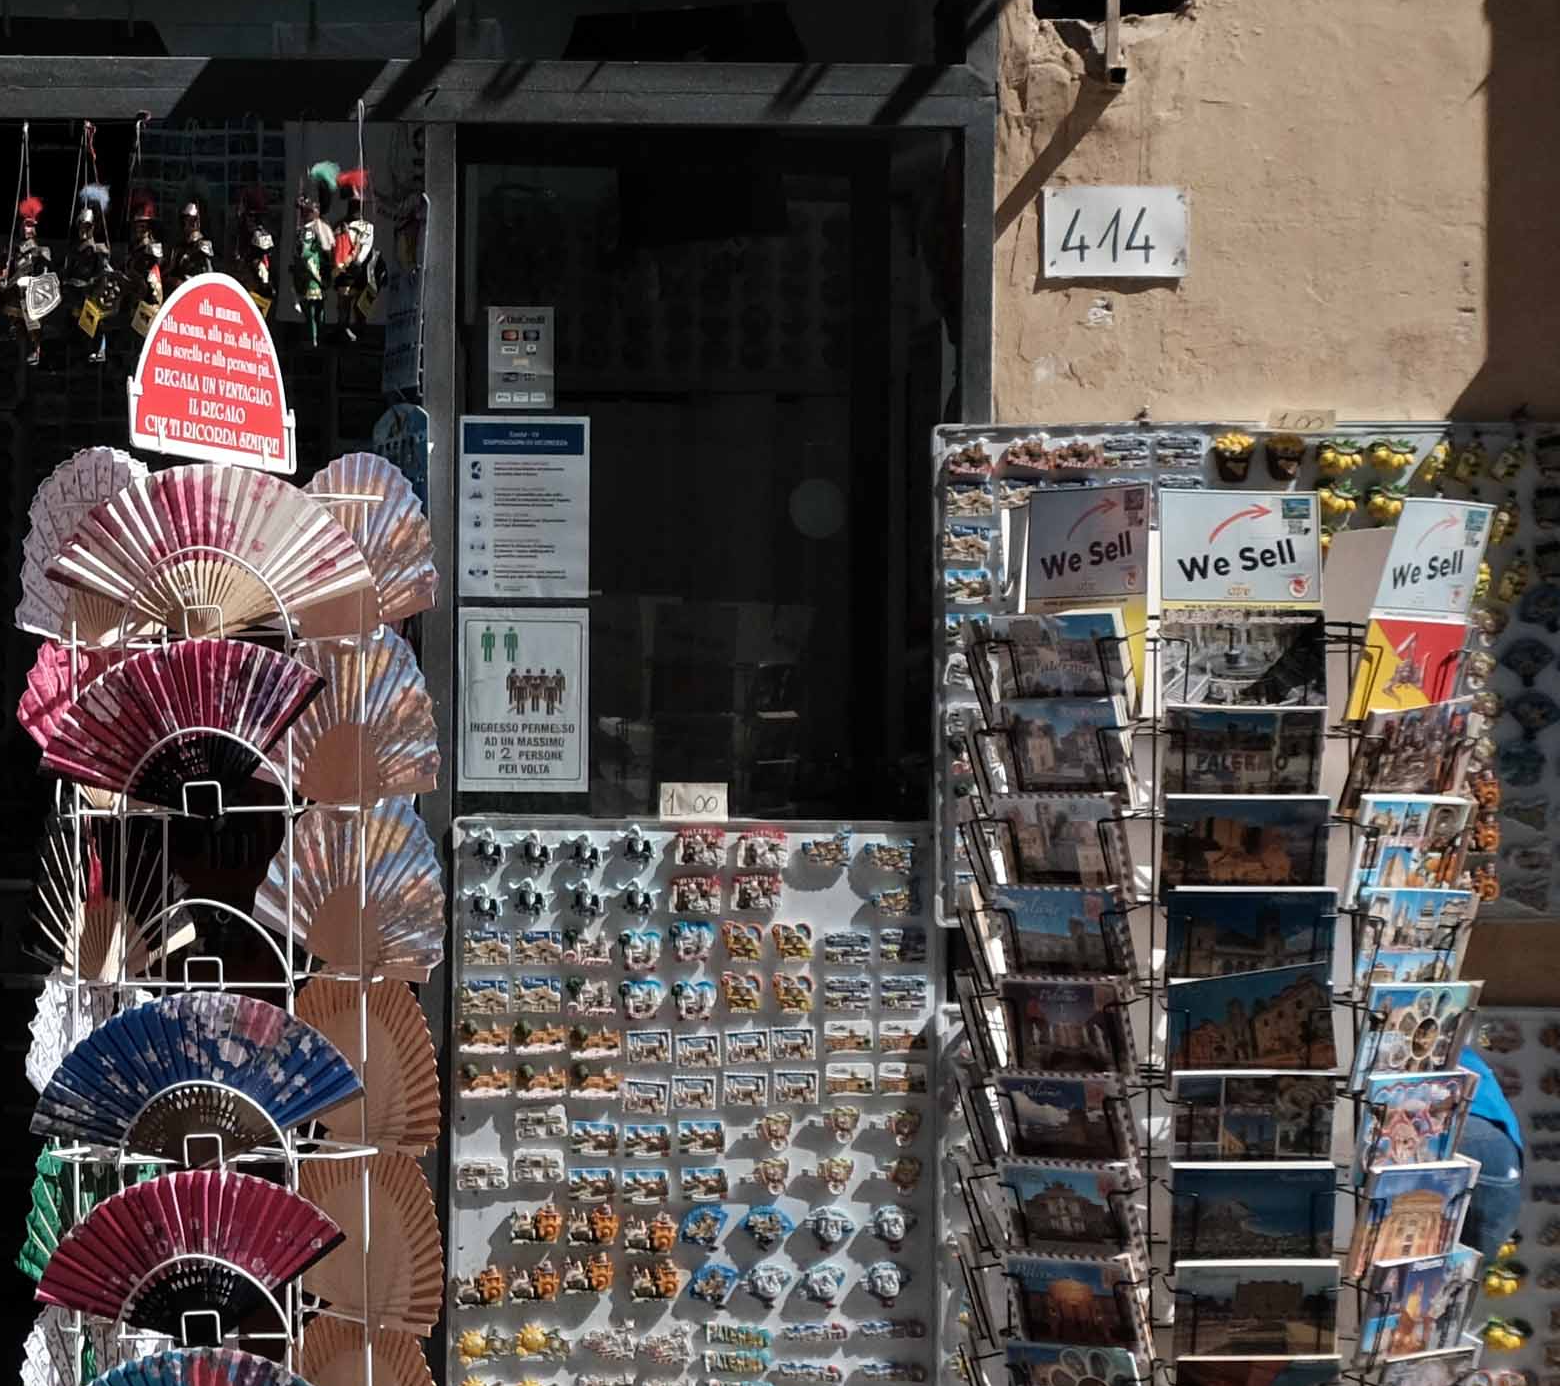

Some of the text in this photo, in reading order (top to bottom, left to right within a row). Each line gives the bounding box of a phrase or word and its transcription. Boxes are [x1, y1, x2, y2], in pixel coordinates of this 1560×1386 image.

[1060, 206, 1156, 263] 414
[162, 315, 178, 333] alla
[207, 324, 222, 342] alla
[156, 337, 171, 356] alla
[173, 344, 203, 362] sorella
[203, 353, 210, 364] e
[211, 349, 226, 368] alla
[154, 367, 200, 392] REGALA
[202, 375, 217, 395] UN
[188, 397, 246, 424] IL REGALO
[169, 418, 181, 437] TI
[183, 421, 237, 446] RICORDA
[1041, 530, 1133, 580] We Sell
[1177, 538, 1296, 582] We Sell
[1392, 548, 1464, 590] We Sell
[470, 722, 575, 734] INGRESSO PERMESSO
[484, 736, 565, 747] AD UN MASSIMO
[485, 747, 564, 760] DI 2 PERSONE
[498, 764, 550, 774] PER VOLTA
